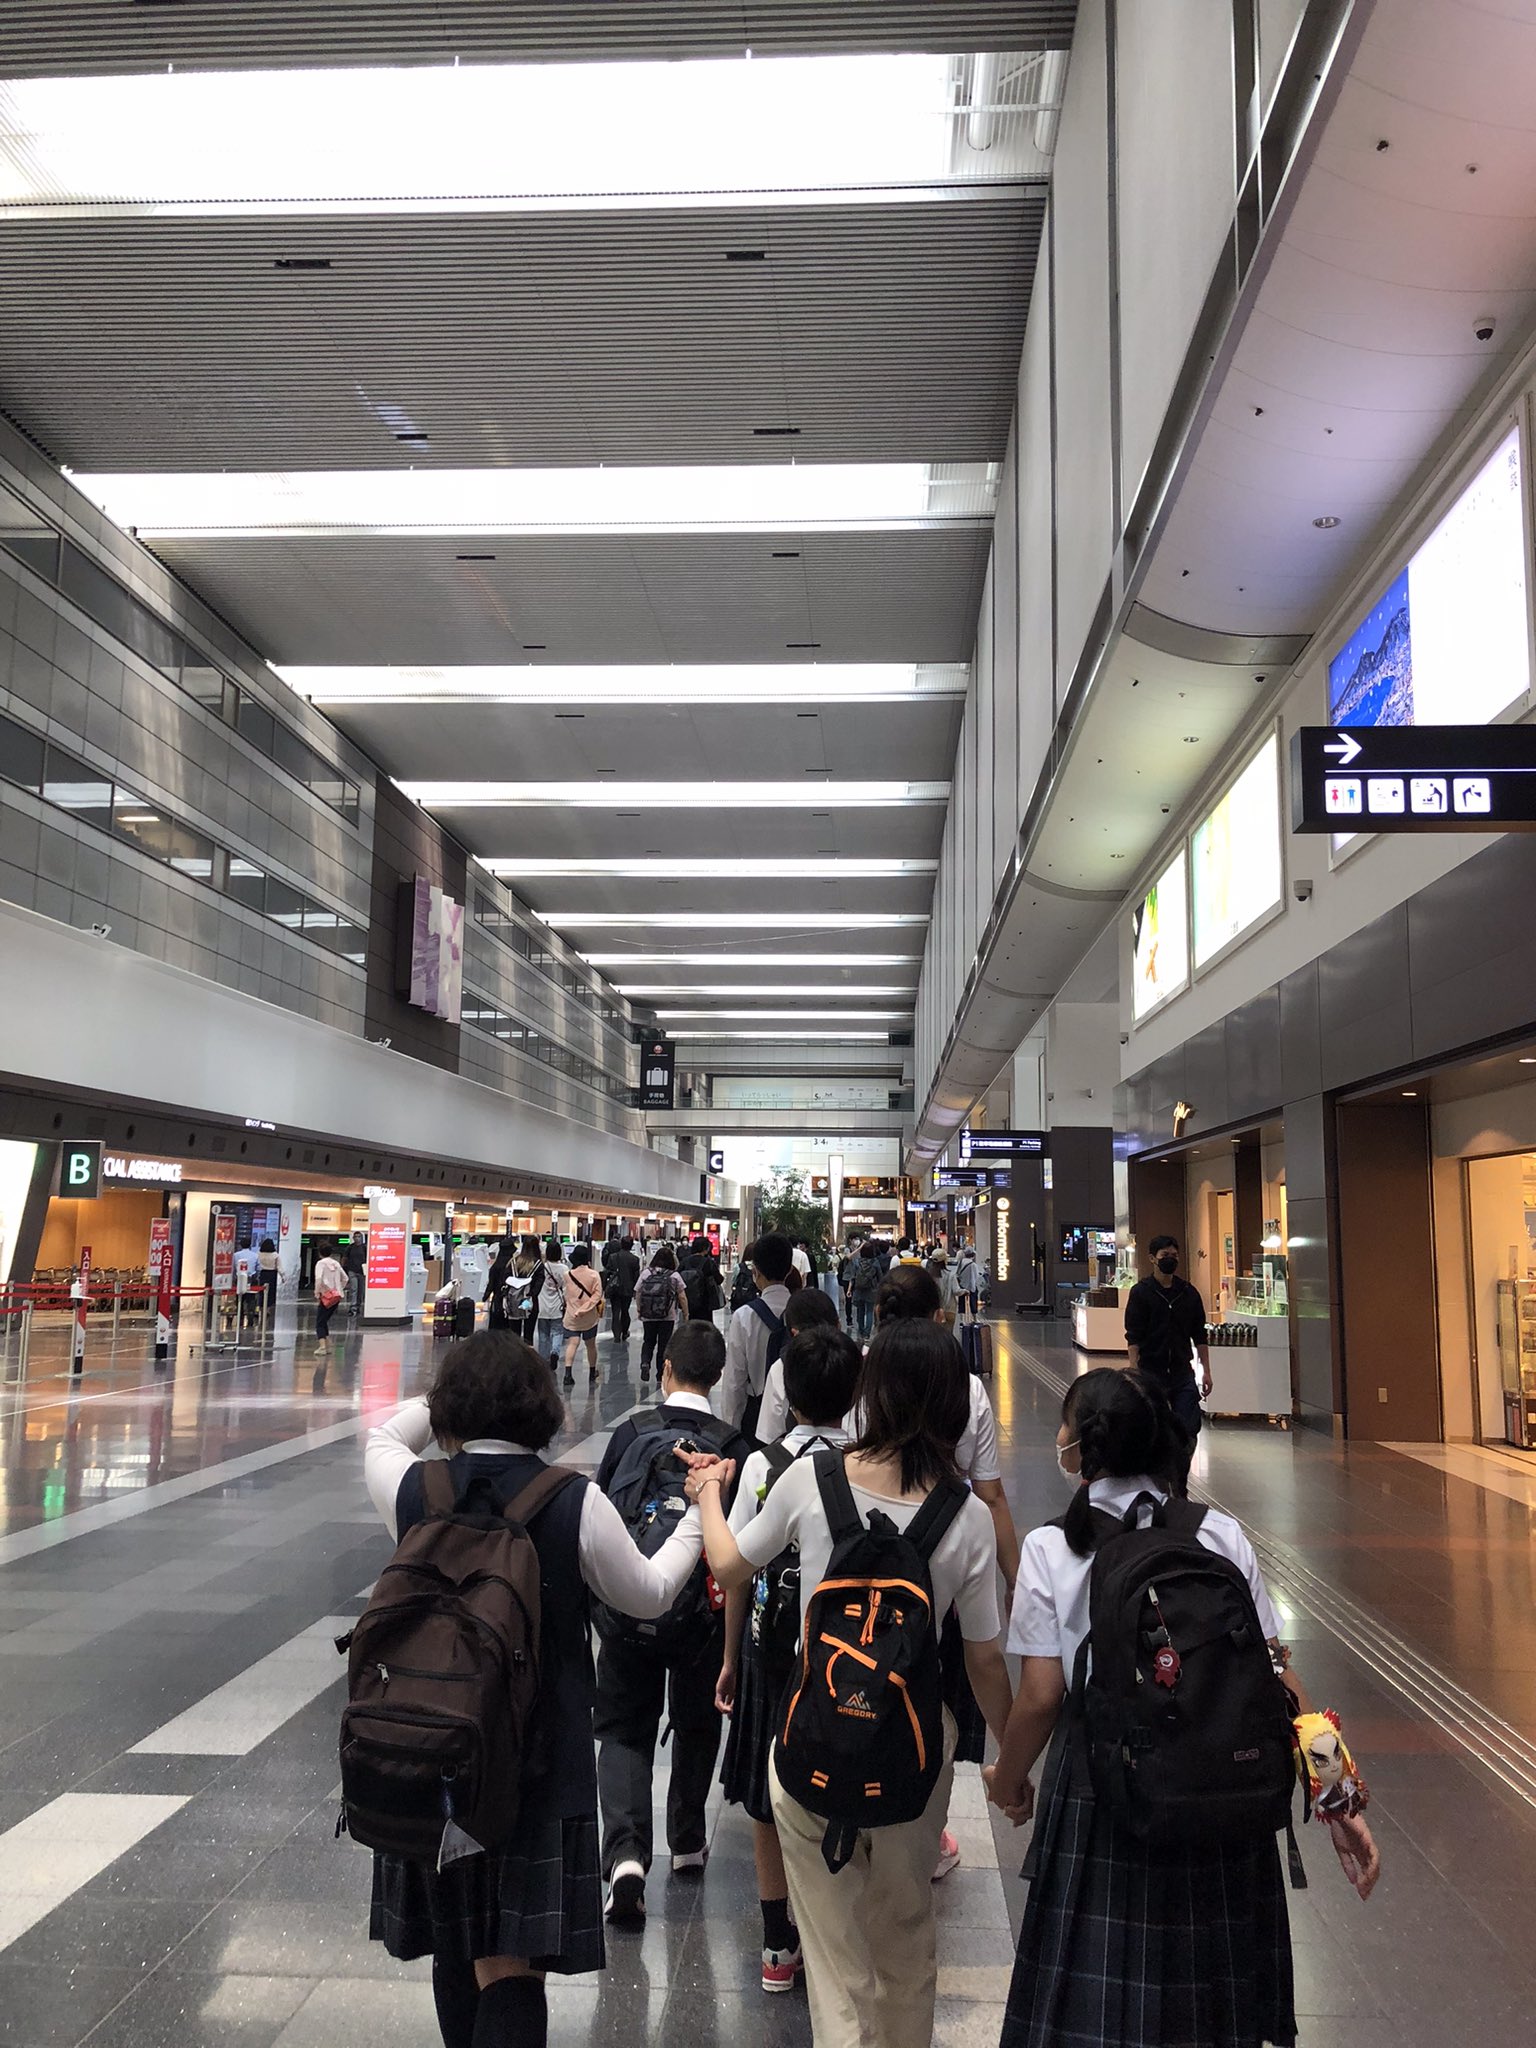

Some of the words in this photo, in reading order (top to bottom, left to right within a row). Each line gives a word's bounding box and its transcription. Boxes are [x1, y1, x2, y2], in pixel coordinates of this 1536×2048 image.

[69, 1153, 91, 1185] B
[126, 1159, 183, 1182] ASSISTANCE
[710, 1153, 723, 1170] C
[997, 1211, 1010, 1281] Information
[83, 1251, 91, 1270] 入口
[163, 1249, 172, 1266] 入口
[837, 1705, 878, 1720] GREGORY
